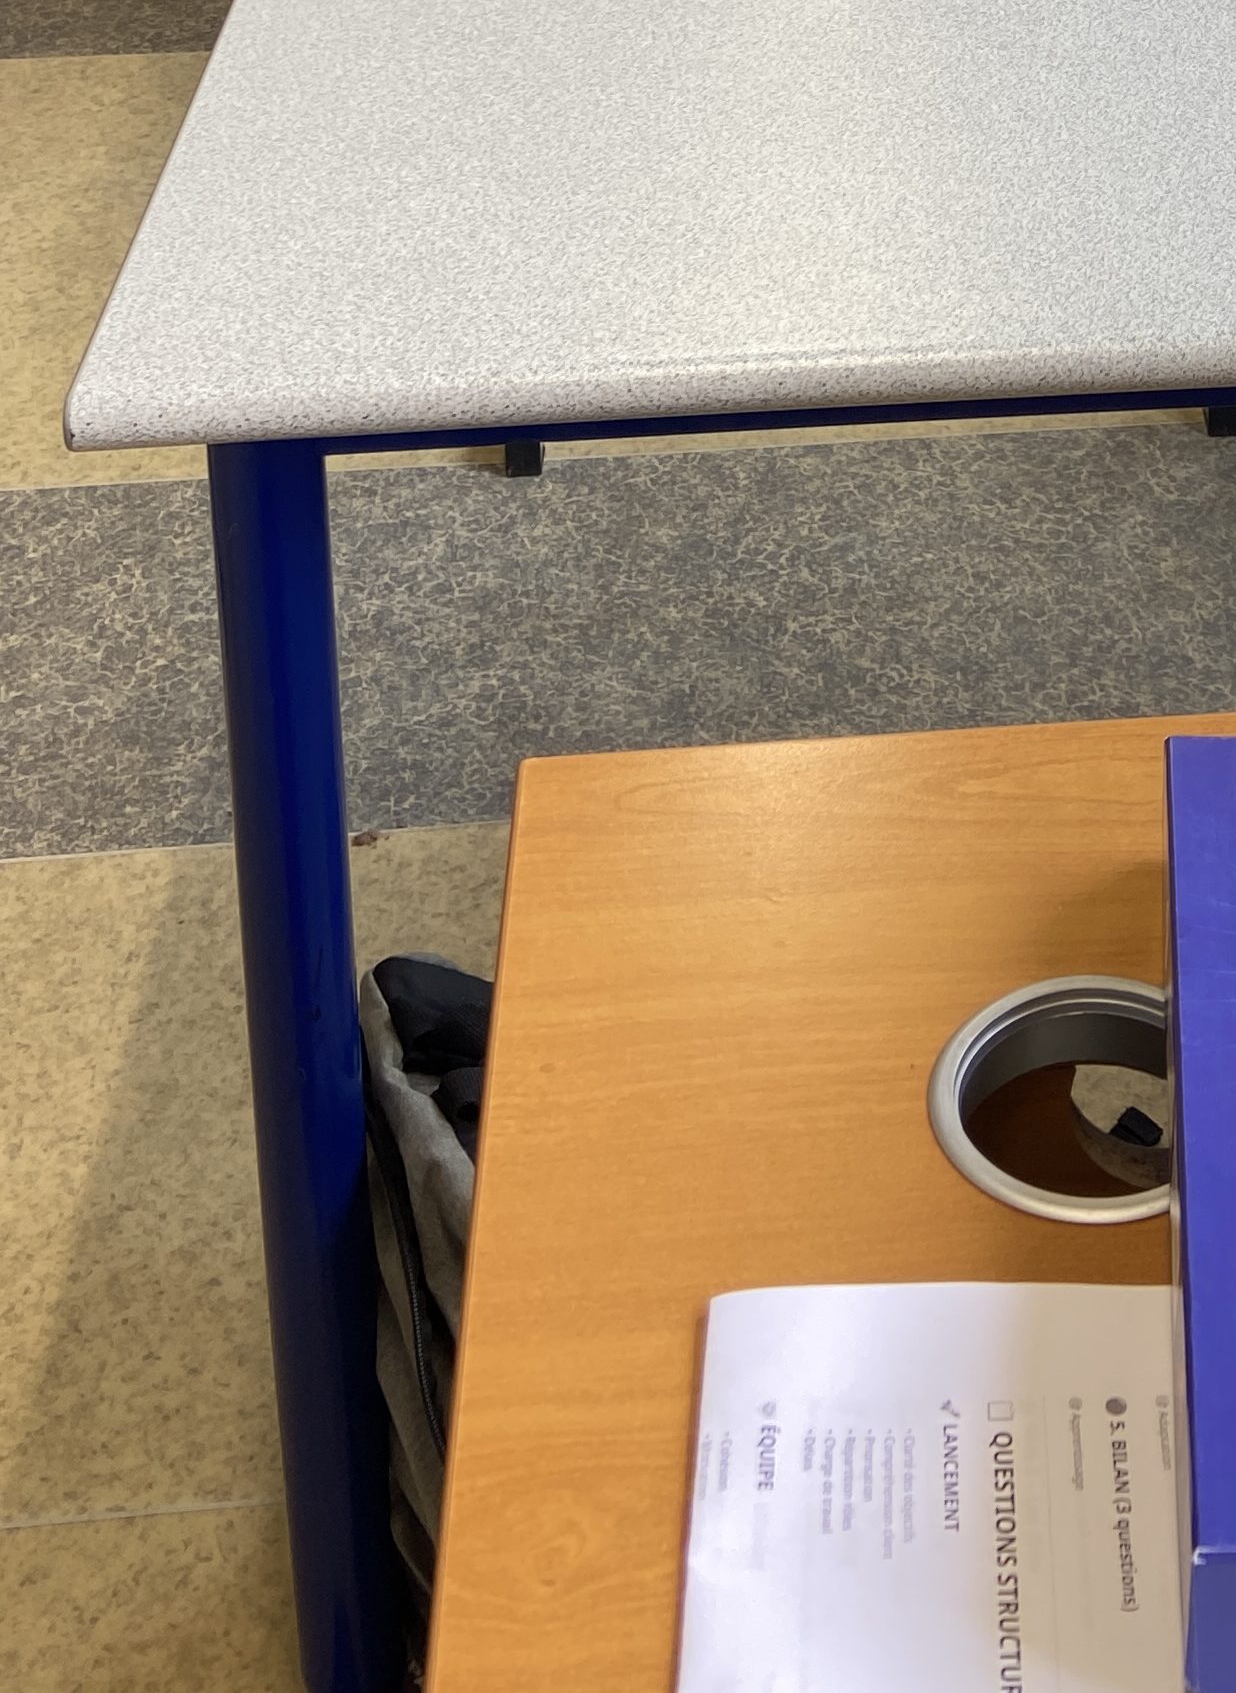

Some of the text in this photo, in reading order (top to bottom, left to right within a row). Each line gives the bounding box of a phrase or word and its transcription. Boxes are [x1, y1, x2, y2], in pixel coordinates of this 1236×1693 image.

[756, 1425, 781, 1490] ÉQUIPE
[823, 1480, 833, 1495] de
[944, 1424, 959, 1532] LANCEMENT
[1112, 1440, 1131, 1494] BILAN
[989, 1432, 1017, 1566] QUESTIONS
[1112, 1497, 1132, 1514] (3
[1113, 1519, 1139, 1612] questions)
